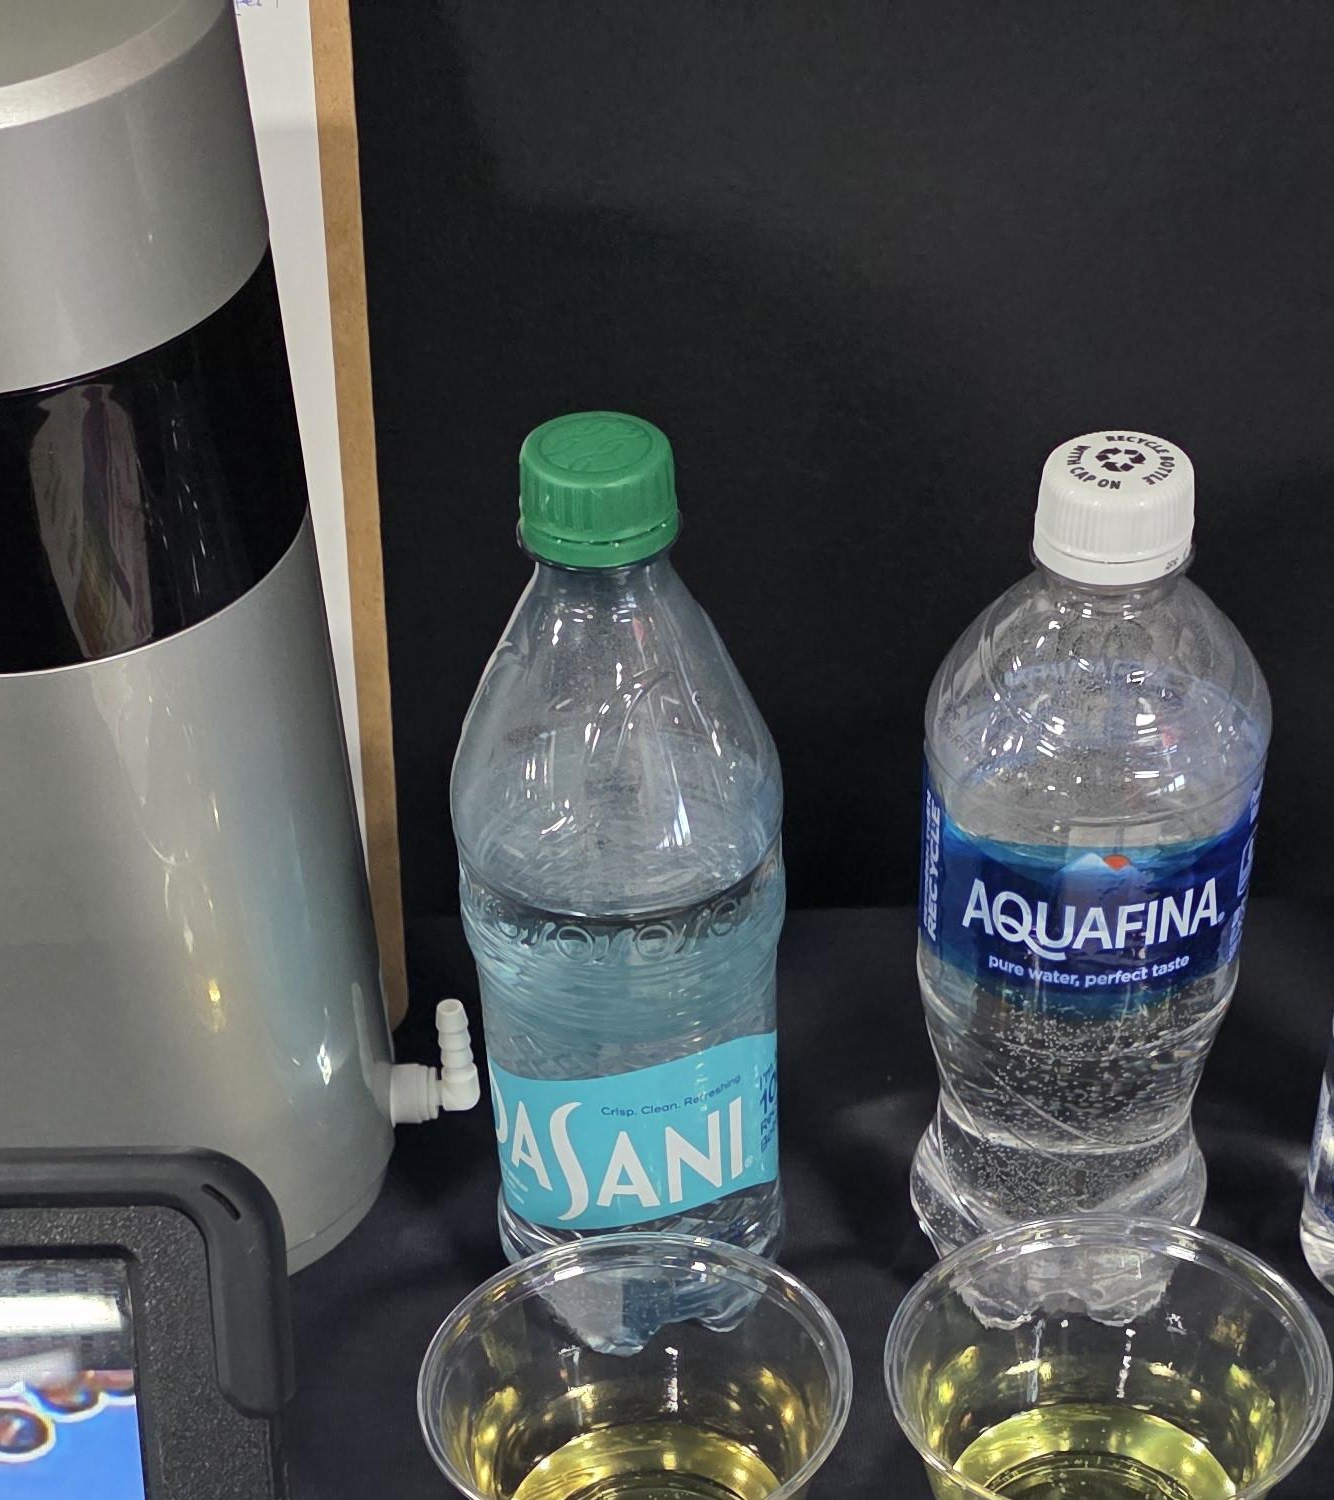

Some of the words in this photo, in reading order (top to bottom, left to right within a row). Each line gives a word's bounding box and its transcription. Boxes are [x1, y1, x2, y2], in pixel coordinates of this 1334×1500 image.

[1067, 445, 1091, 466] WITH
[1105, 435, 1170, 455] RECYCLE
[1070, 467, 1097, 483] CAP
[1097, 478, 1121, 489] ON
[1142, 456, 1175, 486] BOTTLE
[927, 806, 940, 942] RECYCLE
[962, 877, 1218, 961] AQUAFINA
[988, 954, 1024, 977] pure
[1029, 966, 1080, 987] water,
[1085, 967, 1148, 988] perfect
[1152, 955, 1190, 976] taste
[601, 1106, 637, 1118] Crisp.
[641, 1103, 680, 1115] Clean.
[684, 1074, 741, 1106] Refreshing
